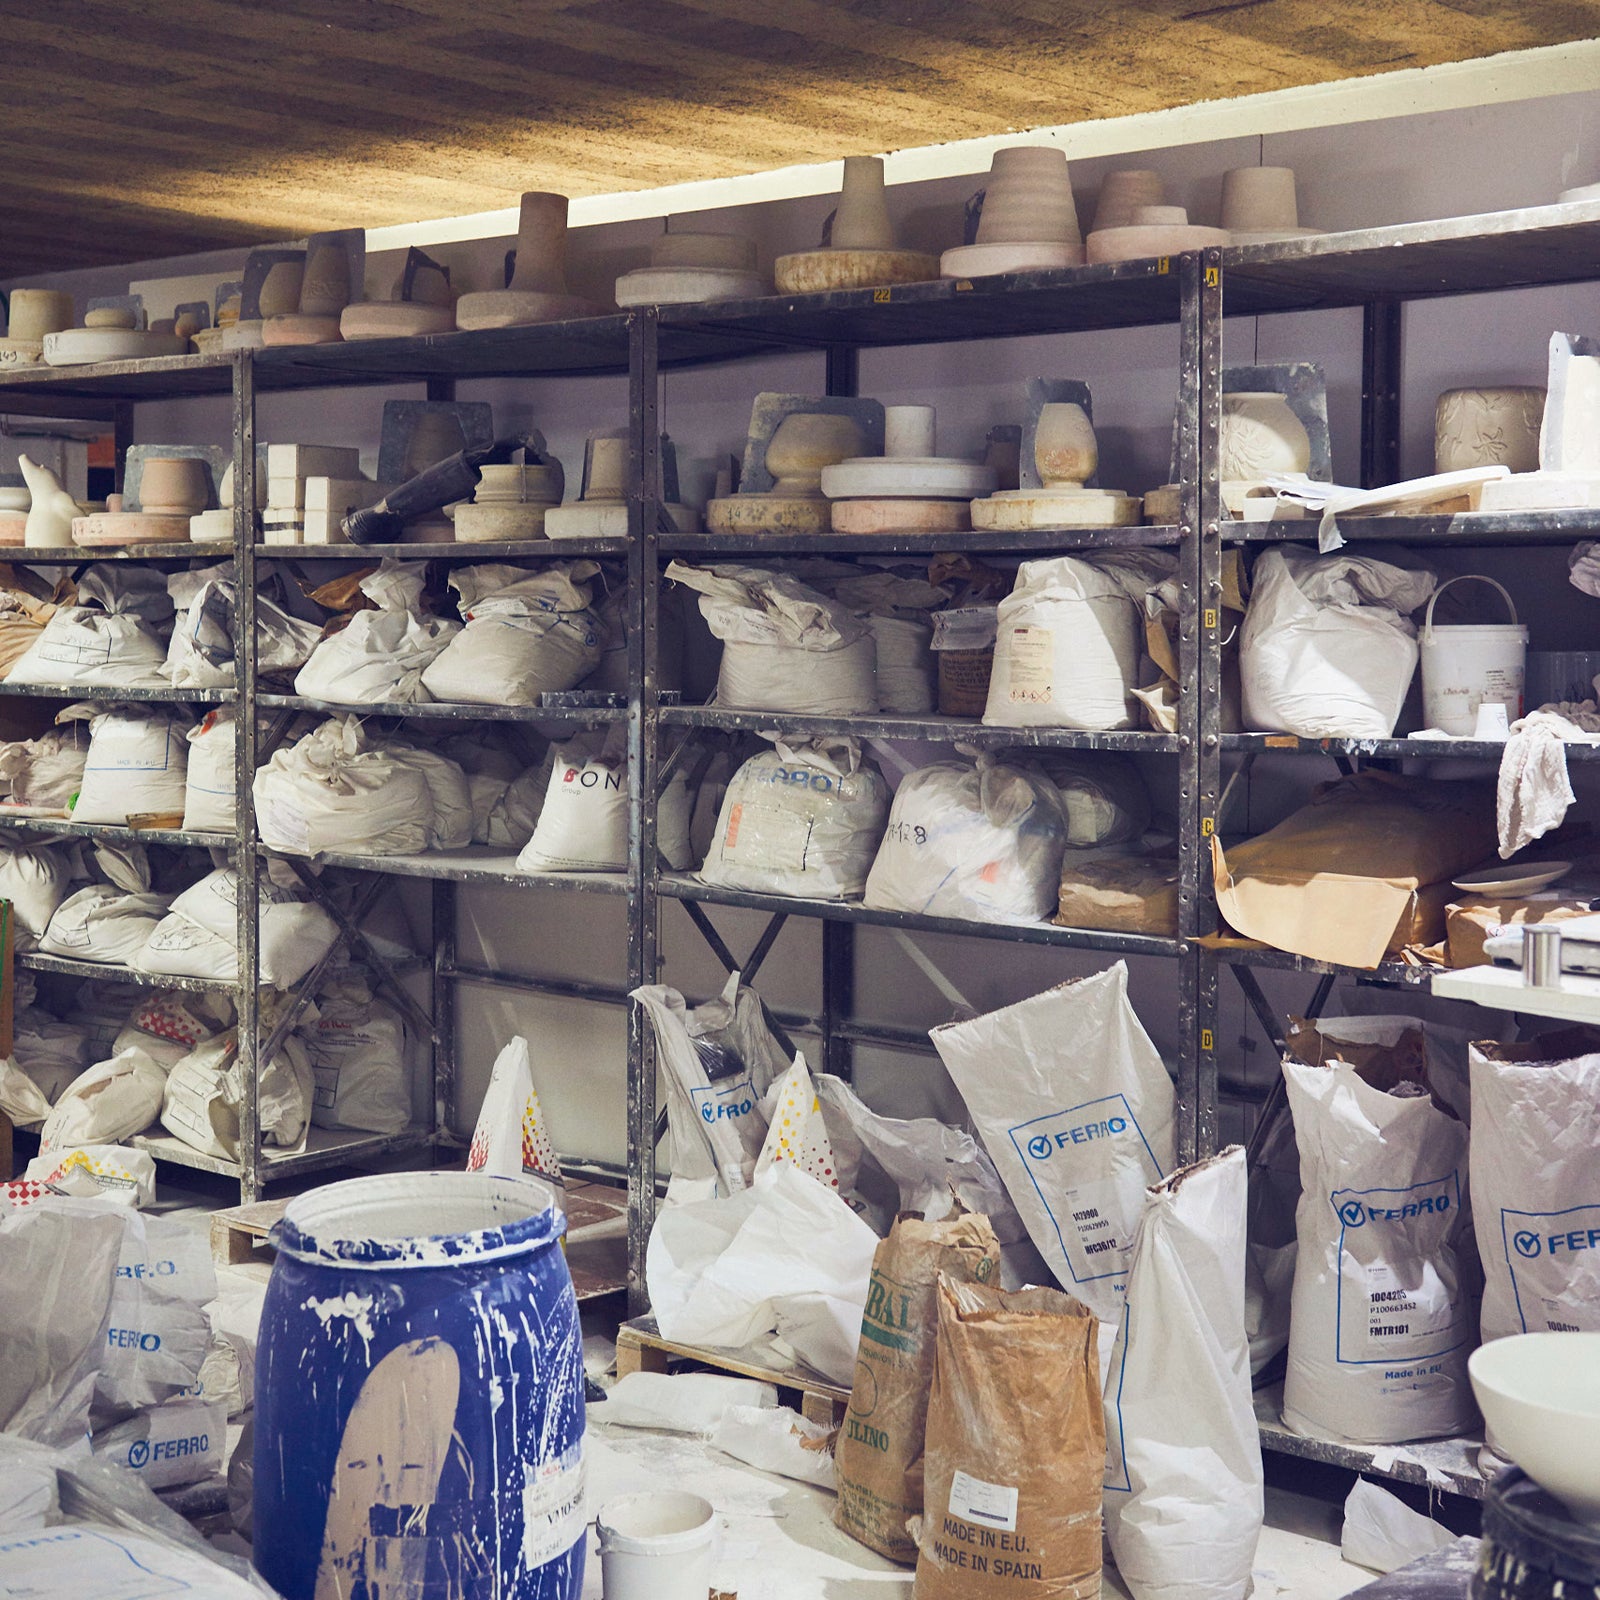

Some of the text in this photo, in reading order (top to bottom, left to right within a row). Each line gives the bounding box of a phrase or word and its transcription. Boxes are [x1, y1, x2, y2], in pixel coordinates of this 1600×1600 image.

[1208, 270, 1215, 284] A
[874, 289, 889, 301] 22
[1207, 612, 1214, 626] B
[1205, 820, 1212, 834] C
[1204, 1033, 1211, 1046] D
[1367, 1195, 1450, 1222] FERRO
[1384, 1369, 1414, 1380] Made
[1416, 1367, 1427, 1376] in
[153, 1433, 208, 1461] FERRO
[943, 1518, 1030, 1553] MADE IN E.U.
[933, 1541, 1042, 1580] MADE IN SPAIN
